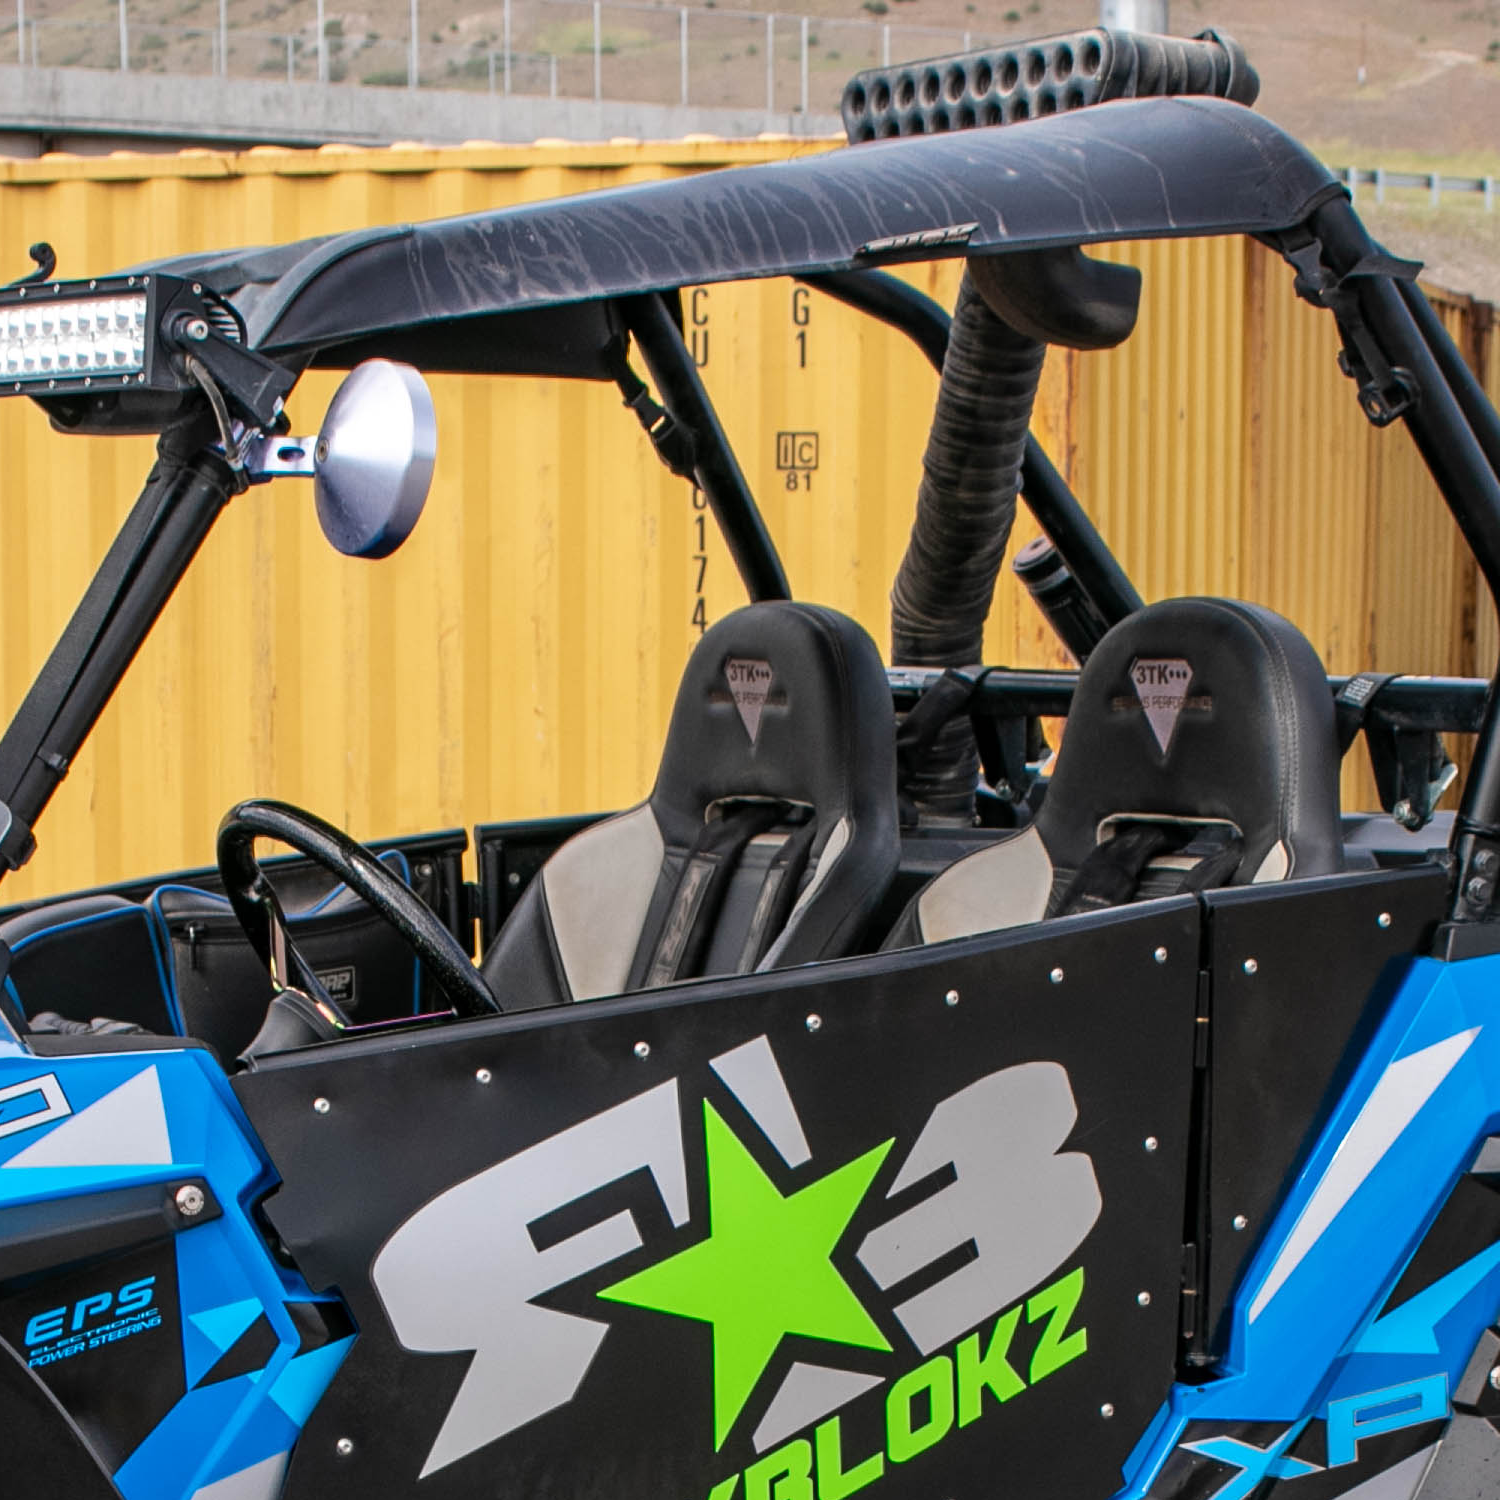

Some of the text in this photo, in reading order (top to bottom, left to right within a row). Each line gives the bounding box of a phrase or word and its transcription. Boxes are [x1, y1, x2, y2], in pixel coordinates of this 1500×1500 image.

[786, 472, 812, 491] 81
[24, 1275, 157, 1347] EPS
[30, 1307, 160, 1357] ELECTRONIC
[28, 1315, 162, 1369] POWER STEERING
